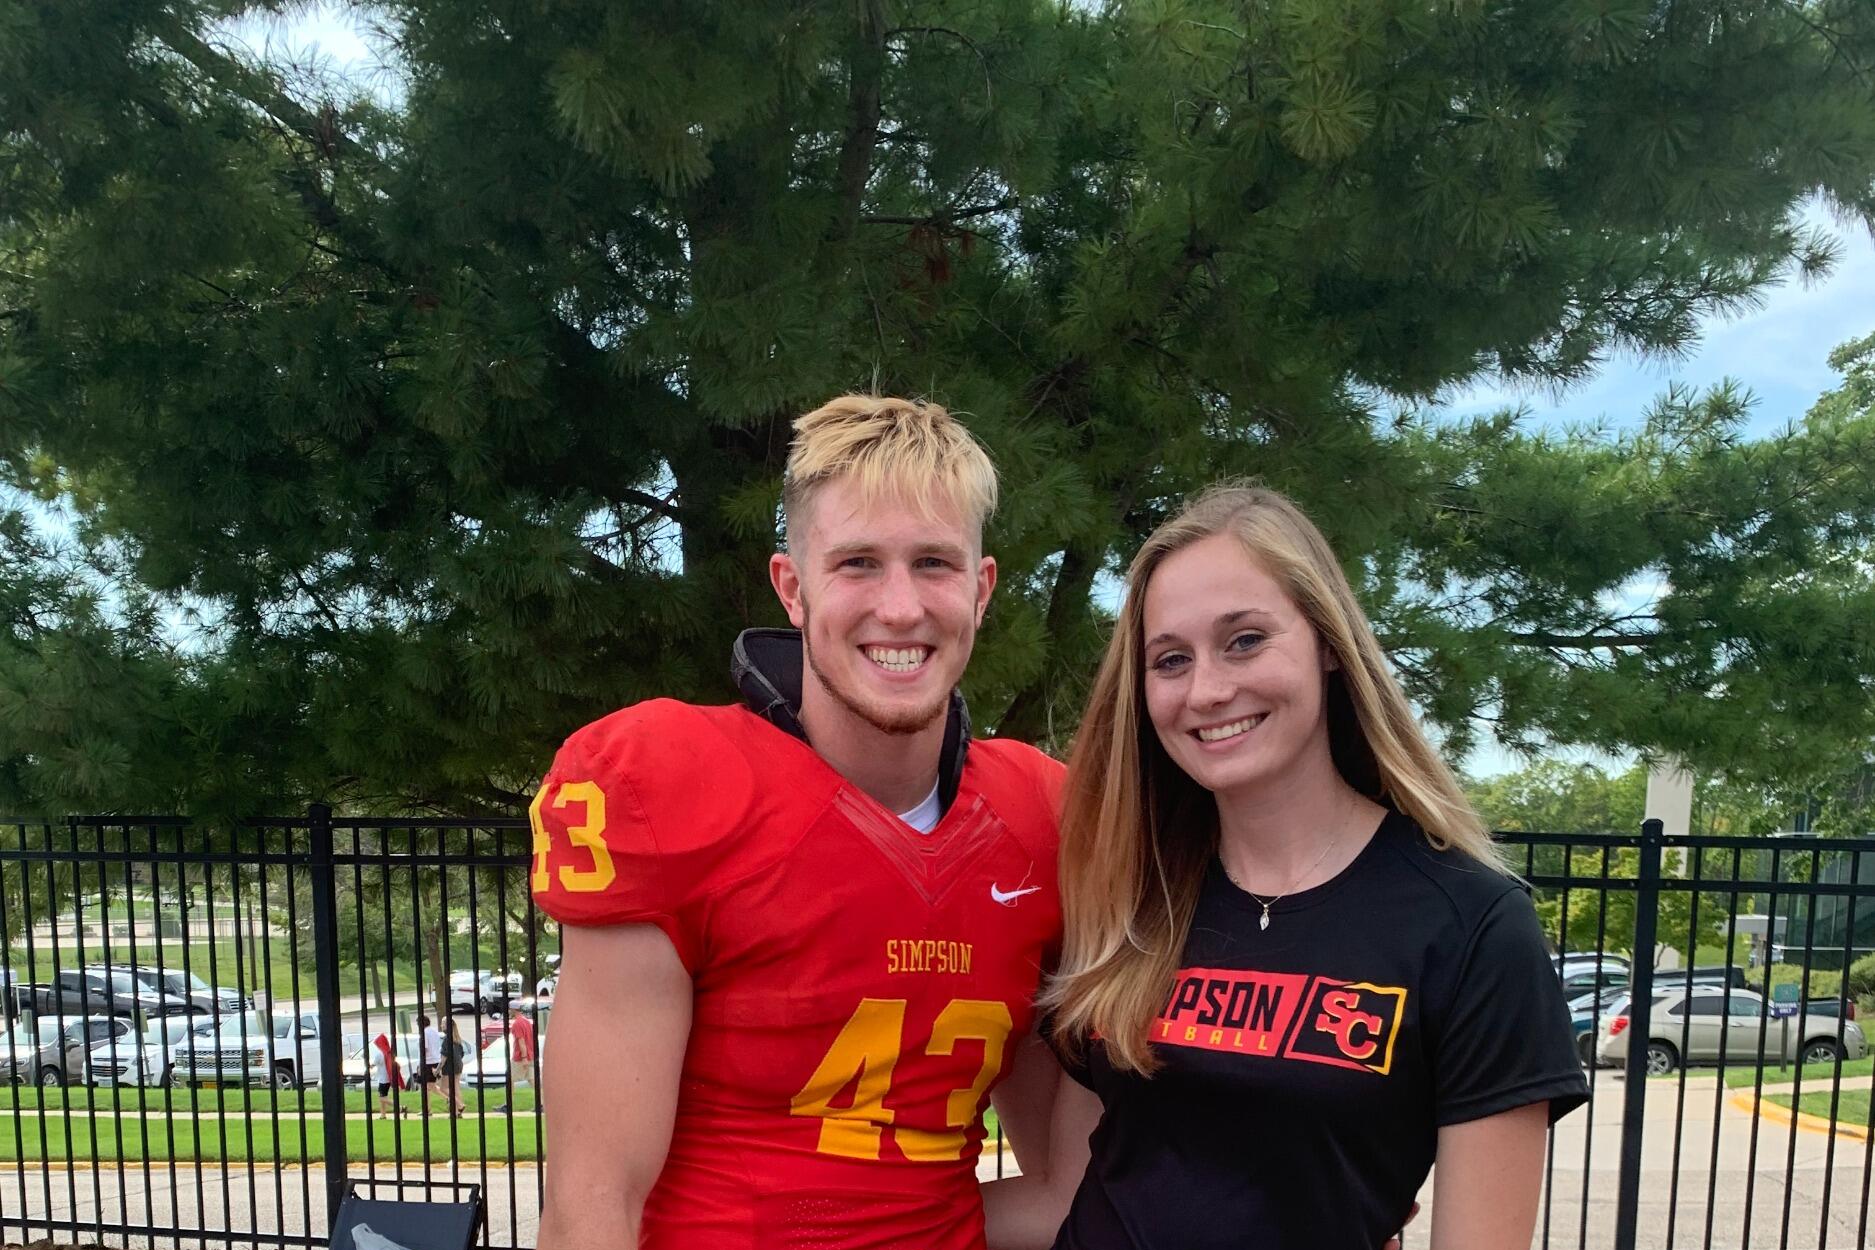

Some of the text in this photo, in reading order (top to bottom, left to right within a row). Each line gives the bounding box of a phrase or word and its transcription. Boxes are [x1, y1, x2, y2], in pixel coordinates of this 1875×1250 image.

[528, 780, 617, 893] 43
[886, 939, 973, 974] SIMPSON
[1158, 976, 1285, 1033] PSON
[789, 997, 1014, 1162] 43
